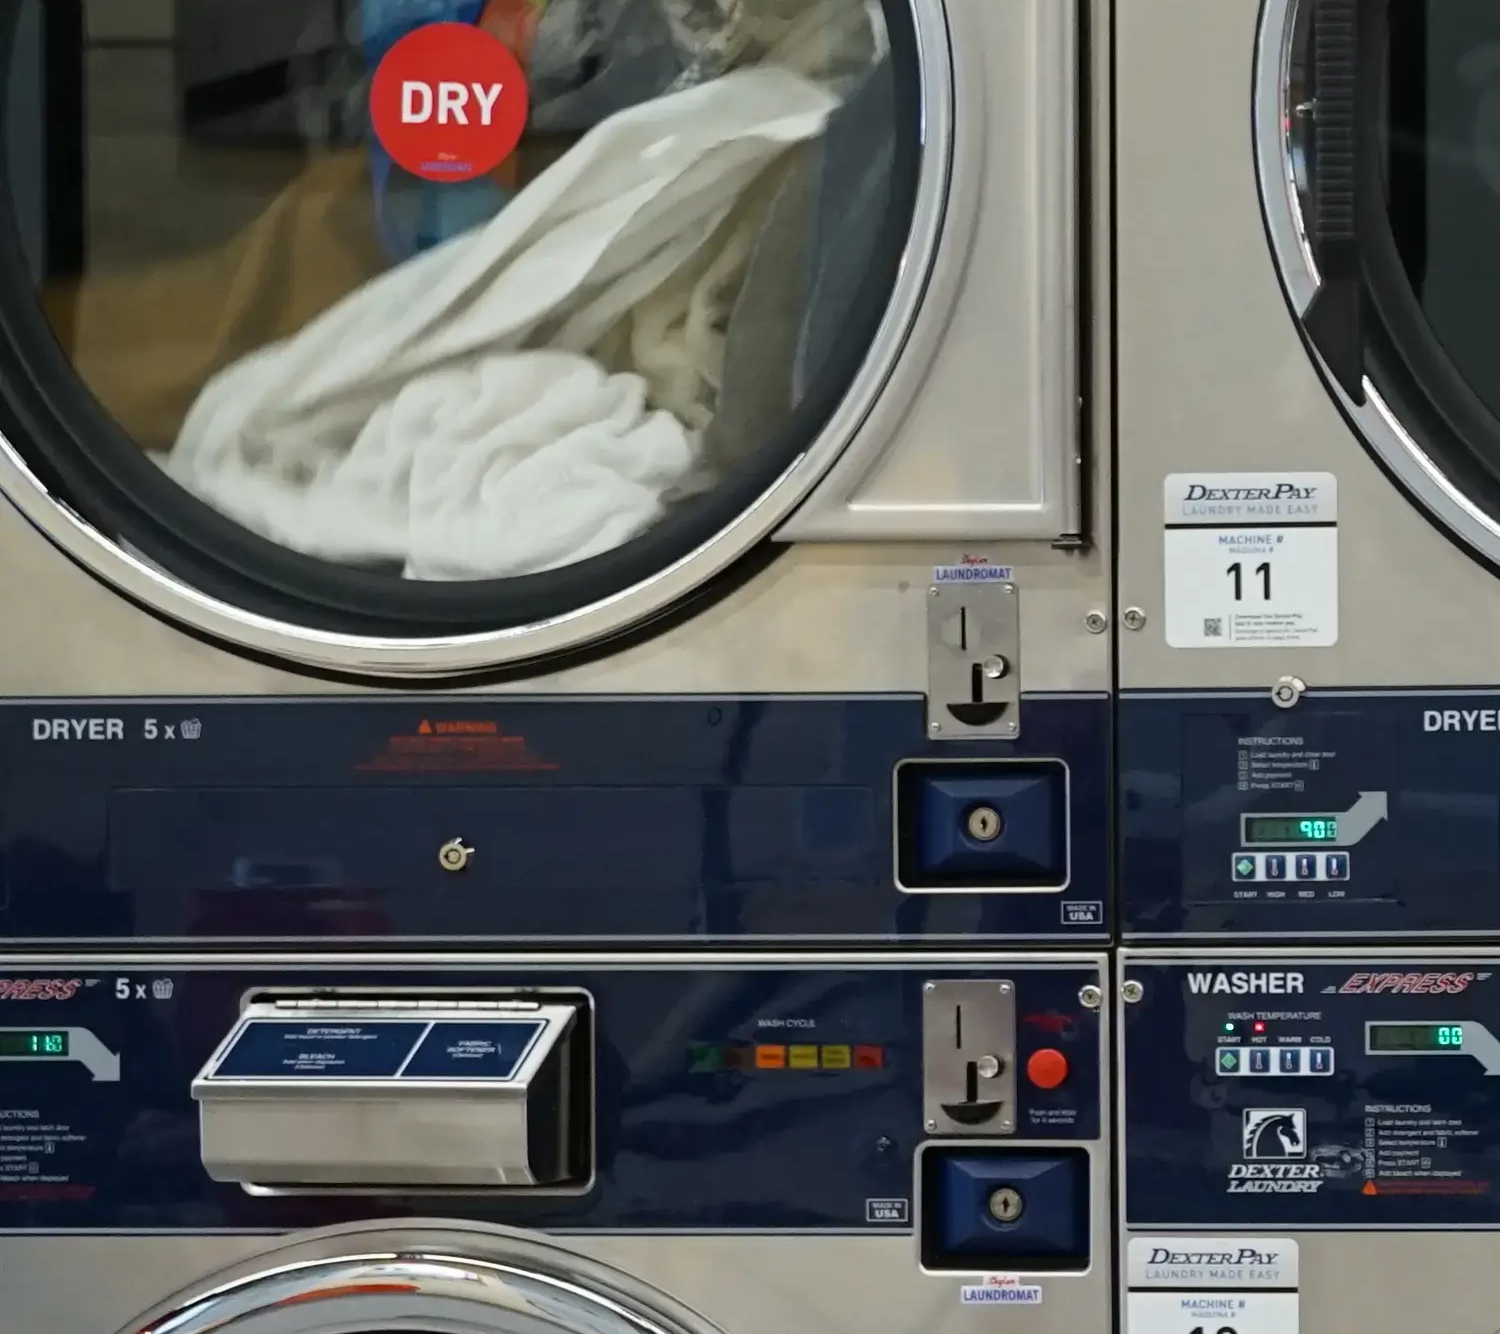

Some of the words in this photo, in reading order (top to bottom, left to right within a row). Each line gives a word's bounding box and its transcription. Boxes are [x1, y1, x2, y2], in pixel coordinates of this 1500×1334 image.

[402, 82, 502, 125] DRY
[935, 568, 1012, 581] LAUNDROMAT
[1227, 563, 1270, 600] 11
[34, 719, 123, 739] DRYER
[1188, 973, 1303, 994] WASHER
[963, 1288, 1040, 1302] LAUNDROMAT
